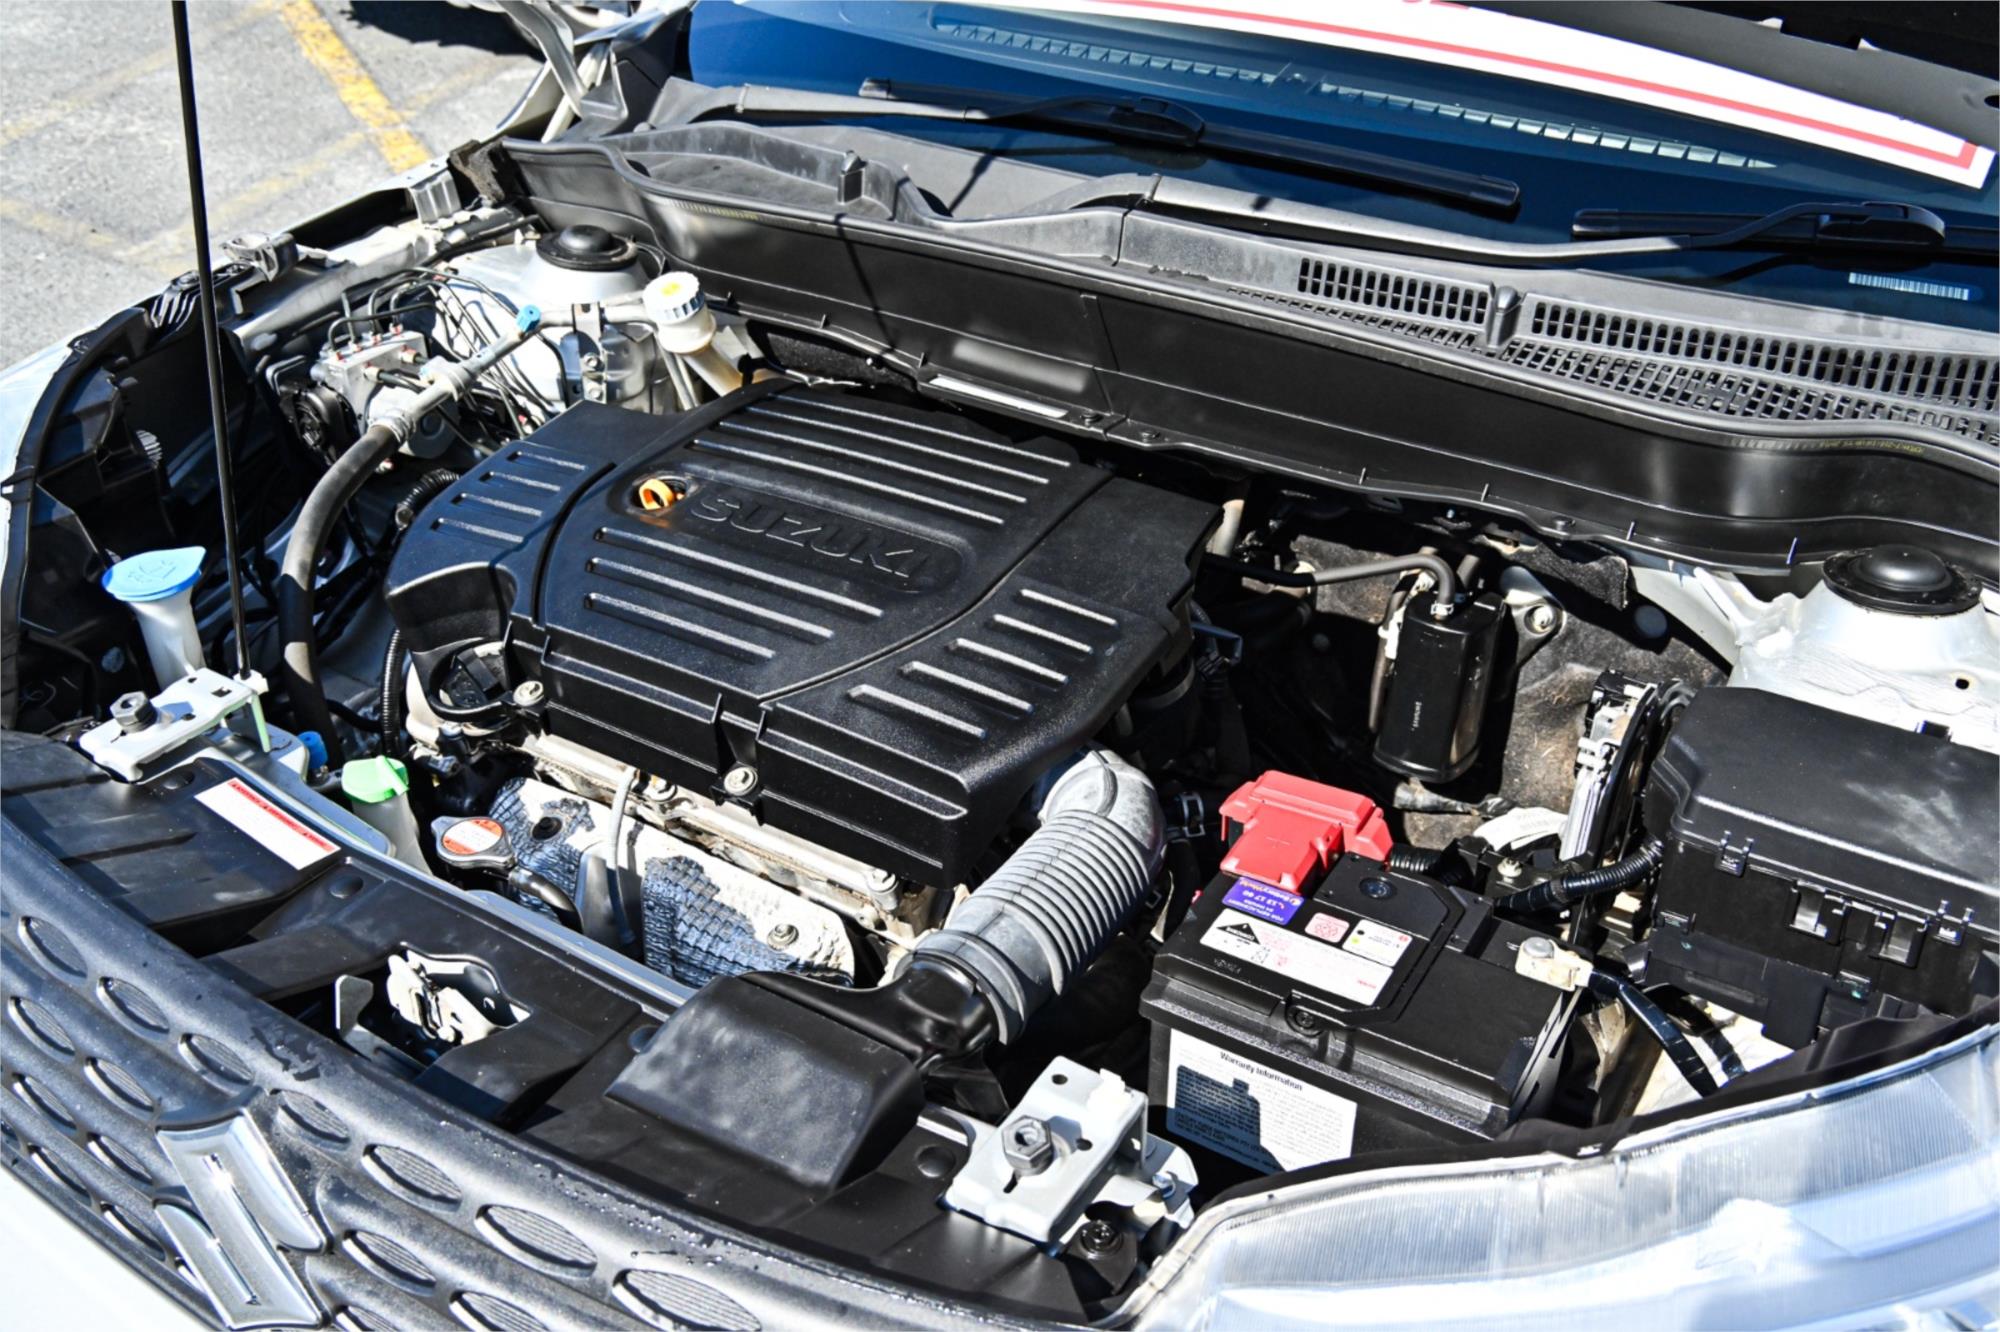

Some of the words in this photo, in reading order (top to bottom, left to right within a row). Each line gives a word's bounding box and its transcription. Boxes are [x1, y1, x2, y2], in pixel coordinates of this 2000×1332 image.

[690, 498, 930, 578] SUZUKI
[1220, 1051, 1255, 1074] Warranty
[1256, 1067, 1303, 1091] Information
